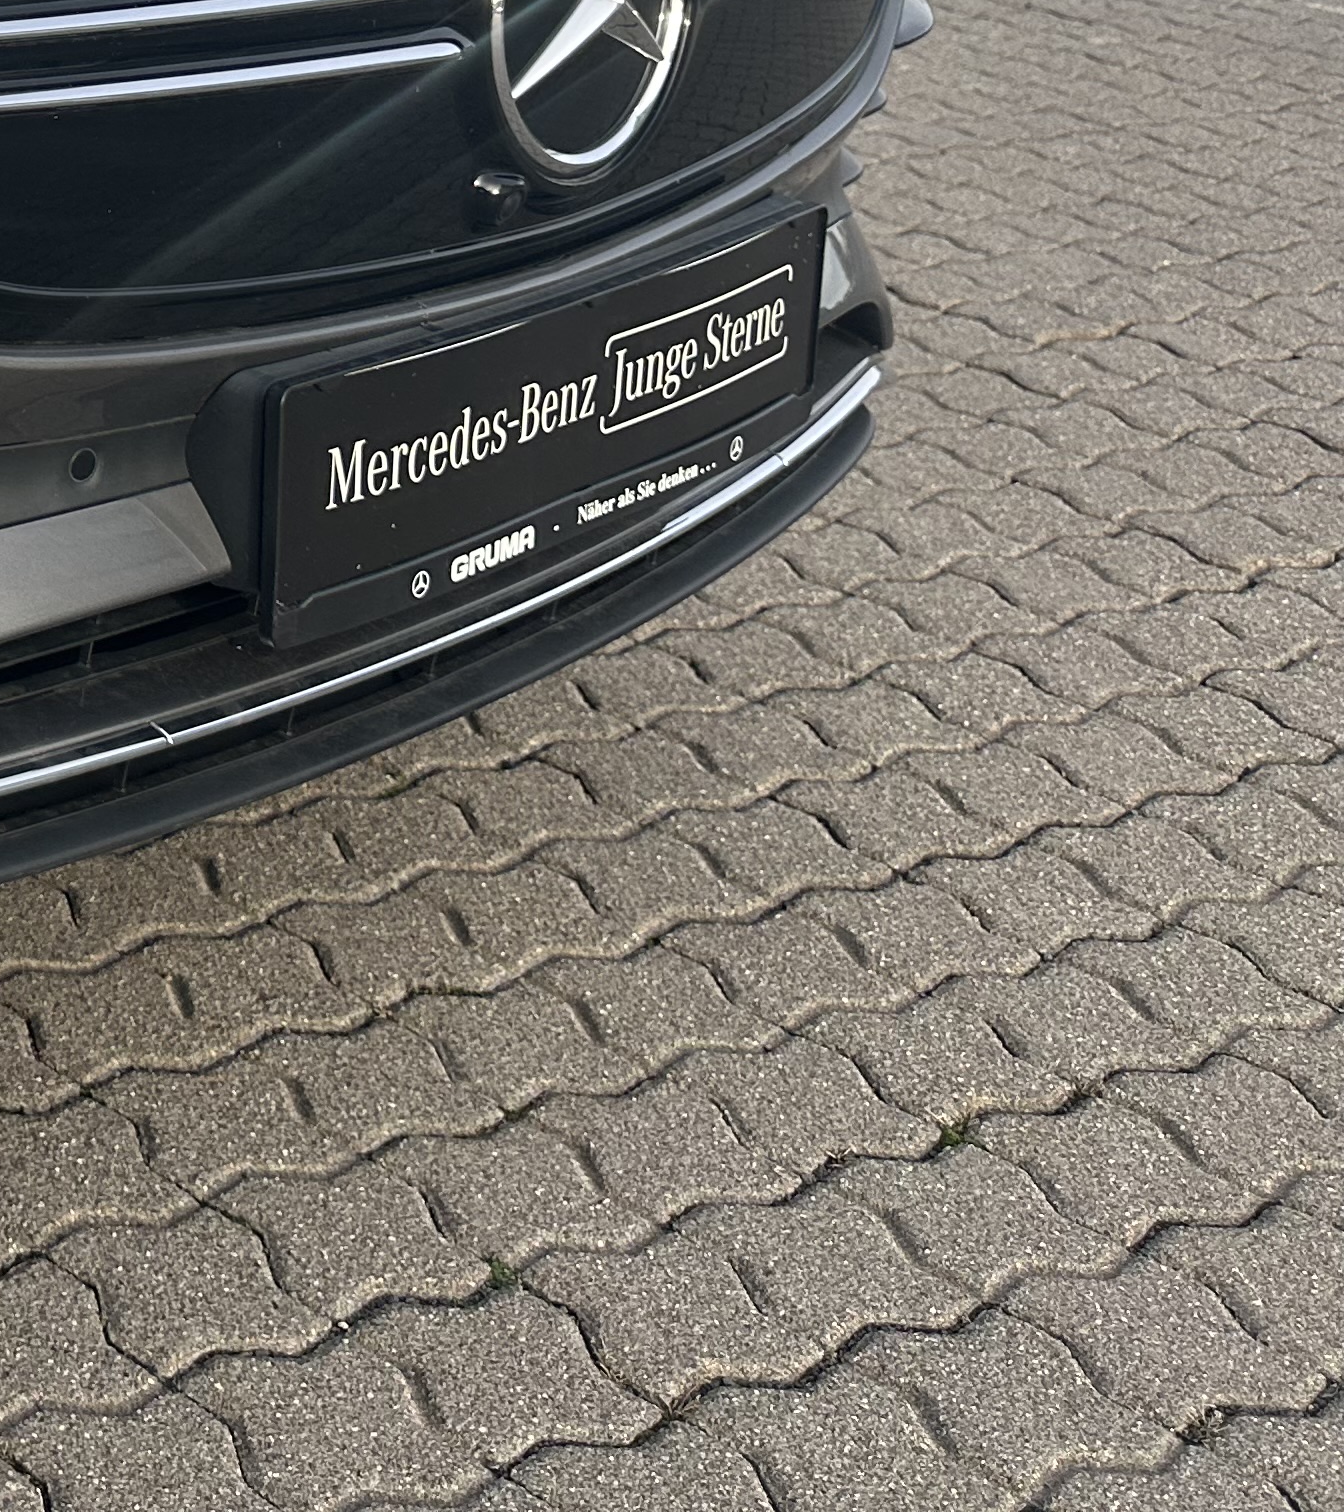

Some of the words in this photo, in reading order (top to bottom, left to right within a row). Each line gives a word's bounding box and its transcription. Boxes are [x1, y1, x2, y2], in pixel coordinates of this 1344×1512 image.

[325, 374, 598, 510] Mercedes-Benz
[608, 338, 698, 419] Junge
[702, 297, 786, 371] Sterne
[450, 524, 536, 583] GRUMA
[576, 497, 617, 525] Näher
[616, 487, 636, 509] als
[636, 479, 657, 502] Sie
